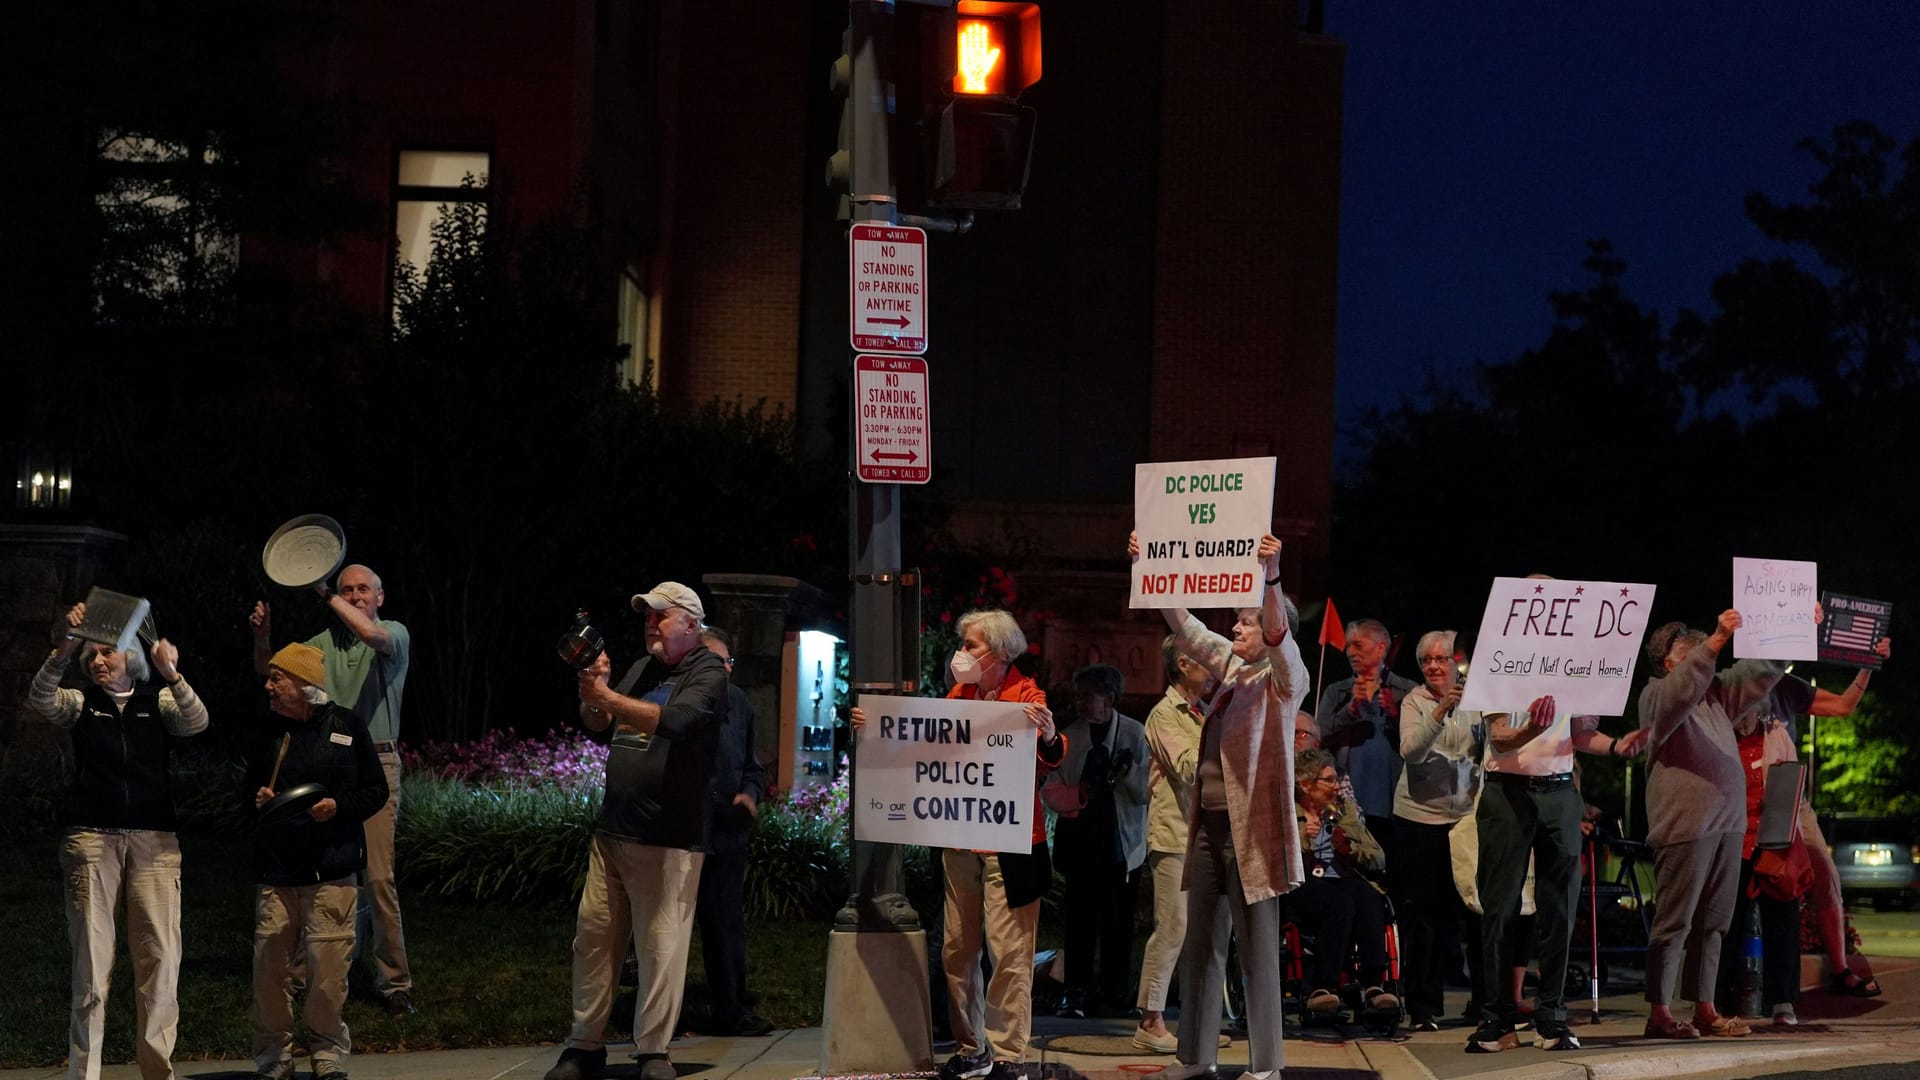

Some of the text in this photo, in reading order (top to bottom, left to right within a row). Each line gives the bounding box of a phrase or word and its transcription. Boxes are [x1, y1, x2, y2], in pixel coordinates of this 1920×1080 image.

[867, 229, 882, 238] TOW
[881, 245, 896, 258] NO
[863, 262, 914, 277] STANDING
[858, 280, 919, 295] OR PARKING
[866, 298, 912, 312] ANYTIME
[856, 337, 862, 346] IF
[865, 337, 885, 347] TOWED
[896, 339, 911, 349] CALL
[871, 359, 911, 370] TOW AWAY
[885, 373, 899, 387] NO
[869, 388, 917, 405] STANDING
[864, 404, 923, 421] OR PARKING
[867, 437, 892, 445] MONDAY
[898, 438, 920, 447] FRIDAY
[862, 468, 868, 477] IF
[871, 468, 890, 477] TOWED
[900, 469, 915, 478] CALL
[1165, 473, 1243, 494] DC POLICE
[1188, 502, 1216, 524] YES
[1147, 538, 1255, 559] NAT'L GUARD?
[1141, 572, 1253, 595] NOT NEEDED
[1744, 575, 1812, 602] AGING HIPPY
[1830, 597, 1885, 615] PRO-AMERICA
[1502, 598, 1638, 639] FREE DC
[1489, 650, 1536, 674] Send
[1563, 658, 1592, 676] Guard
[1598, 657, 1631, 678] Home!
[880, 715, 1014, 748] RETURN OUR
[915, 760, 995, 787] POLICE
[869, 796, 1020, 825] to our CONTROL
